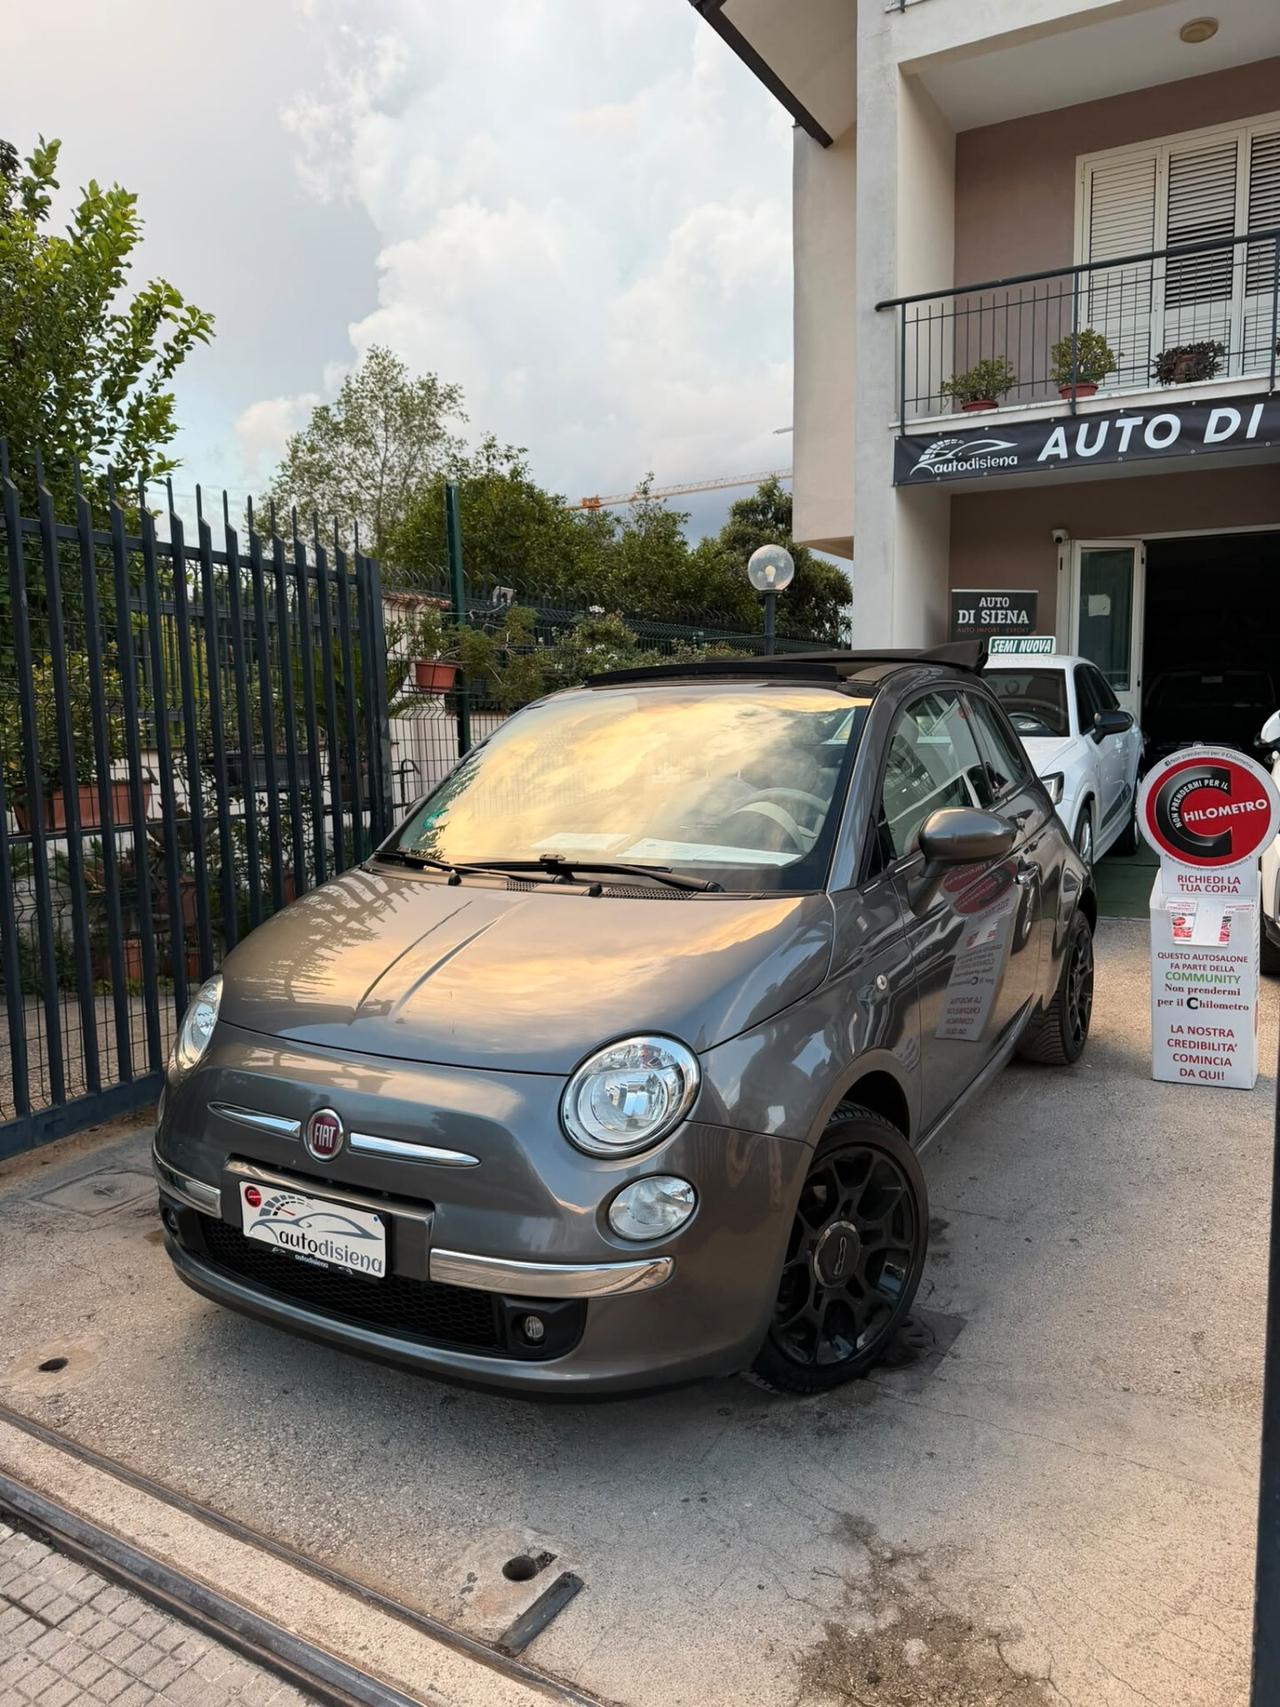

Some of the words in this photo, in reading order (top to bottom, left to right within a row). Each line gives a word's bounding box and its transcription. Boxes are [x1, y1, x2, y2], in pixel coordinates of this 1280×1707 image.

[1037, 414, 1182, 462] AUTO
[1204, 403, 1265, 444] DI
[934, 454, 1018, 474] autodisiena
[979, 597, 1010, 608] AUTO
[957, 610, 976, 624] DI
[981, 610, 1029, 624] SIENA
[993, 640, 1017, 653] SEMI
[1019, 640, 1051, 653] NUOVA
[1204, 779, 1220, 788] PER
[1221, 782, 1229, 790] IL
[1170, 780, 1203, 811] PRENDERMI
[1170, 811, 1182, 828] NON
[1177, 875, 1224, 884] RICHIEDI
[1228, 877, 1241, 885] LA
[1179, 884, 1201, 892] TUA
[1205, 885, 1239, 894] COPIA
[1157, 952, 1190, 961] QUESTO
[1192, 953, 1248, 963] AUTOSALONE
[1182, 964, 1207, 972] PARTE
[1210, 965, 1235, 973] DELLA
[1165, 972, 1241, 984] COMMUNITY
[1164, 983, 1184, 993] Non
[1188, 985, 1241, 996] prendermi
[1157, 999, 1175, 1008] per
[1177, 998, 1184, 1006] il
[1186, 997, 1249, 1011] Chilometro
[1170, 1024, 1184, 1034] LA
[1187, 1026, 1235, 1038] NOSTRA
[1172, 1053, 1232, 1067] COMINCIA
[1179, 1068, 1198, 1078] DA
[1201, 1069, 1225, 1081] QUI!
[314, 1123, 336, 1148] FIAT
[279, 1230, 383, 1273] autodisiena
